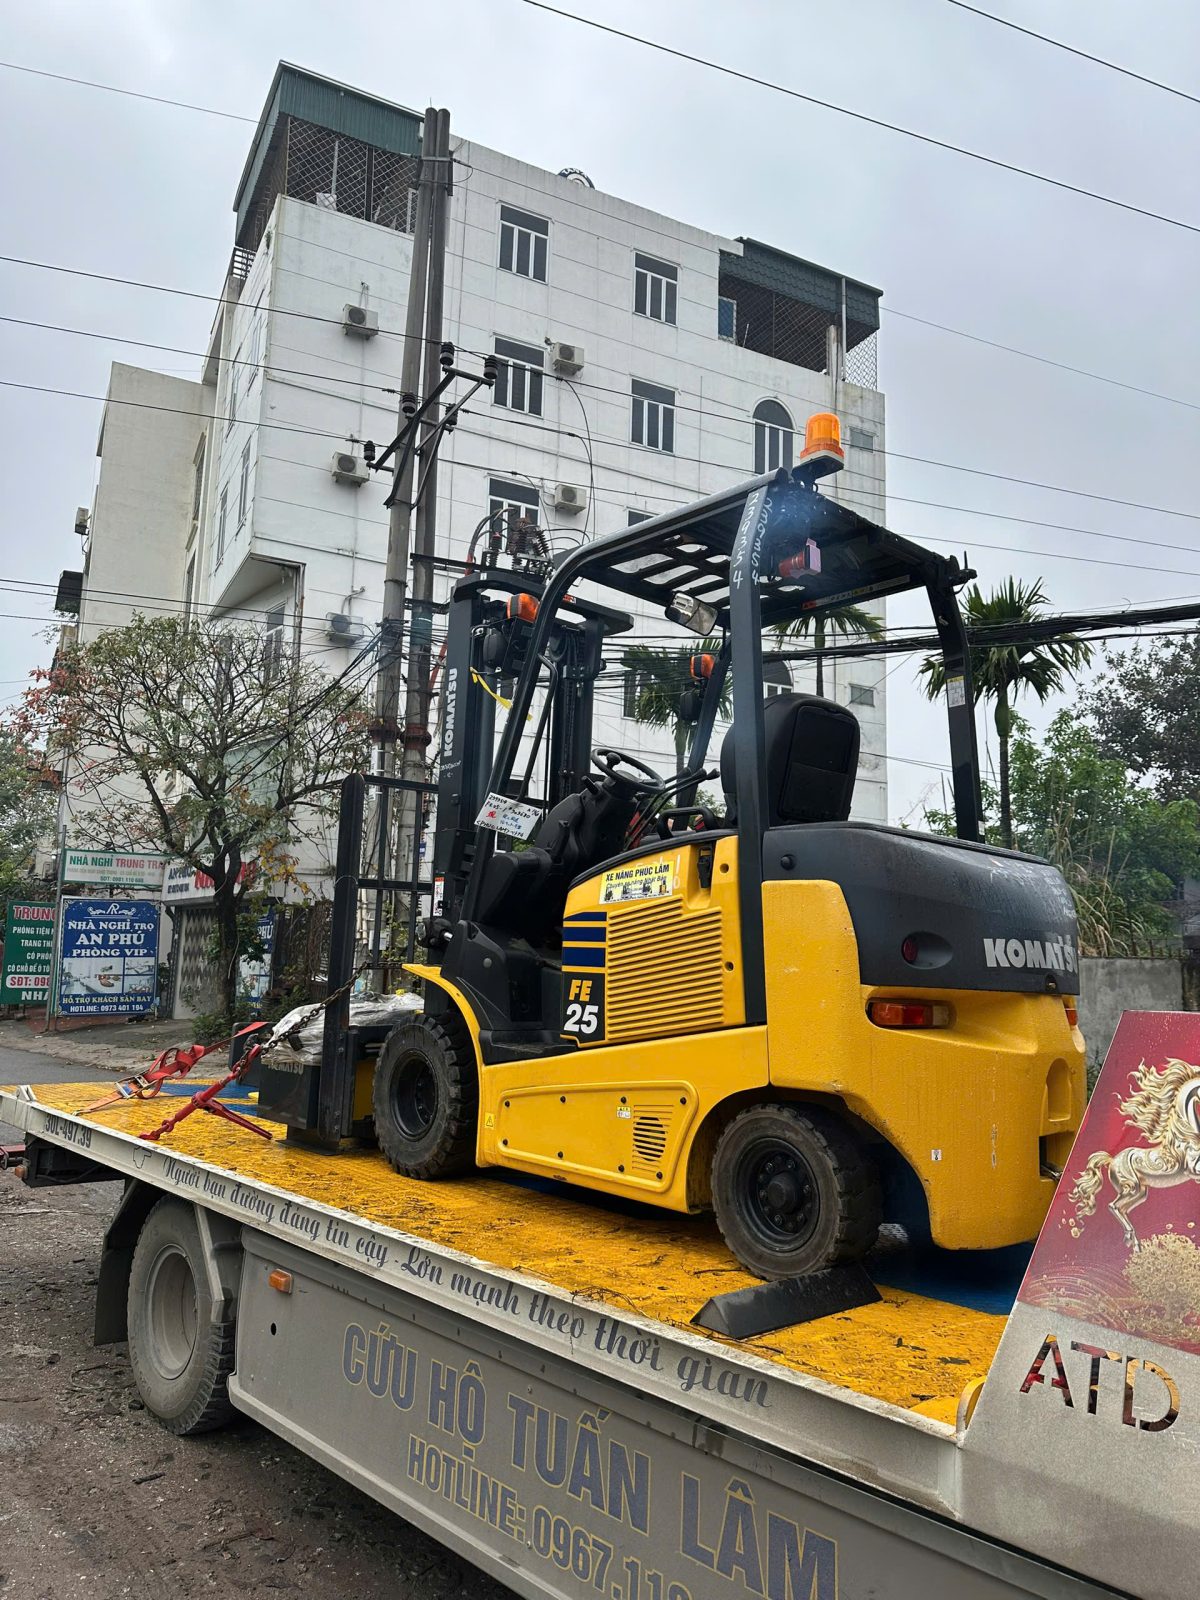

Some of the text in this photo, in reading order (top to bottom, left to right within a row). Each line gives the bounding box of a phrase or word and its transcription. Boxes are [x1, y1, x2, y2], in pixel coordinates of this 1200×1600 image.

[443, 667, 458, 757] KOMATSU
[69, 855, 89, 866] NHÀ
[90, 854, 113, 867] NGHỈ
[115, 857, 145, 869] TRUNG
[606, 873, 614, 882] XE
[615, 869, 634, 880] NÂNG
[654, 863, 670, 874] LÂM
[67, 919, 155, 932] NHÀ NGHỈ TRỌ
[21, 939, 42, 947] TRANG
[75, 930, 145, 945] AN PHÚ
[26, 951, 36, 960] CÓ
[72, 947, 148, 957] PHÒNG VIP
[10, 976, 32, 986] SĐT:
[568, 979, 593, 1002] FE
[70, 1005, 100, 1013] HOTLINE:
[100, 1004, 117, 1012] 0973
[563, 1003, 599, 1034] 25
[163, 1155, 201, 1189] Người
[203, 1170, 226, 1199] bạn
[230, 1182, 276, 1223] đường
[279, 1200, 322, 1241] đáng
[325, 1218, 351, 1249] tin
[355, 1234, 390, 1269] cậy
[401, 1246, 445, 1286] Lớn
[451, 1271, 522, 1316] mạnh
[528, 1292, 588, 1340] theo
[594, 1318, 664, 1372] thời
[676, 1353, 774, 1408] gian
[1019, 1333, 1182, 1432] ATD
[342, 1321, 838, 1600] CỨU HỘ TUẤN LÂM
[407, 1433, 527, 1544] HOTLINE:
